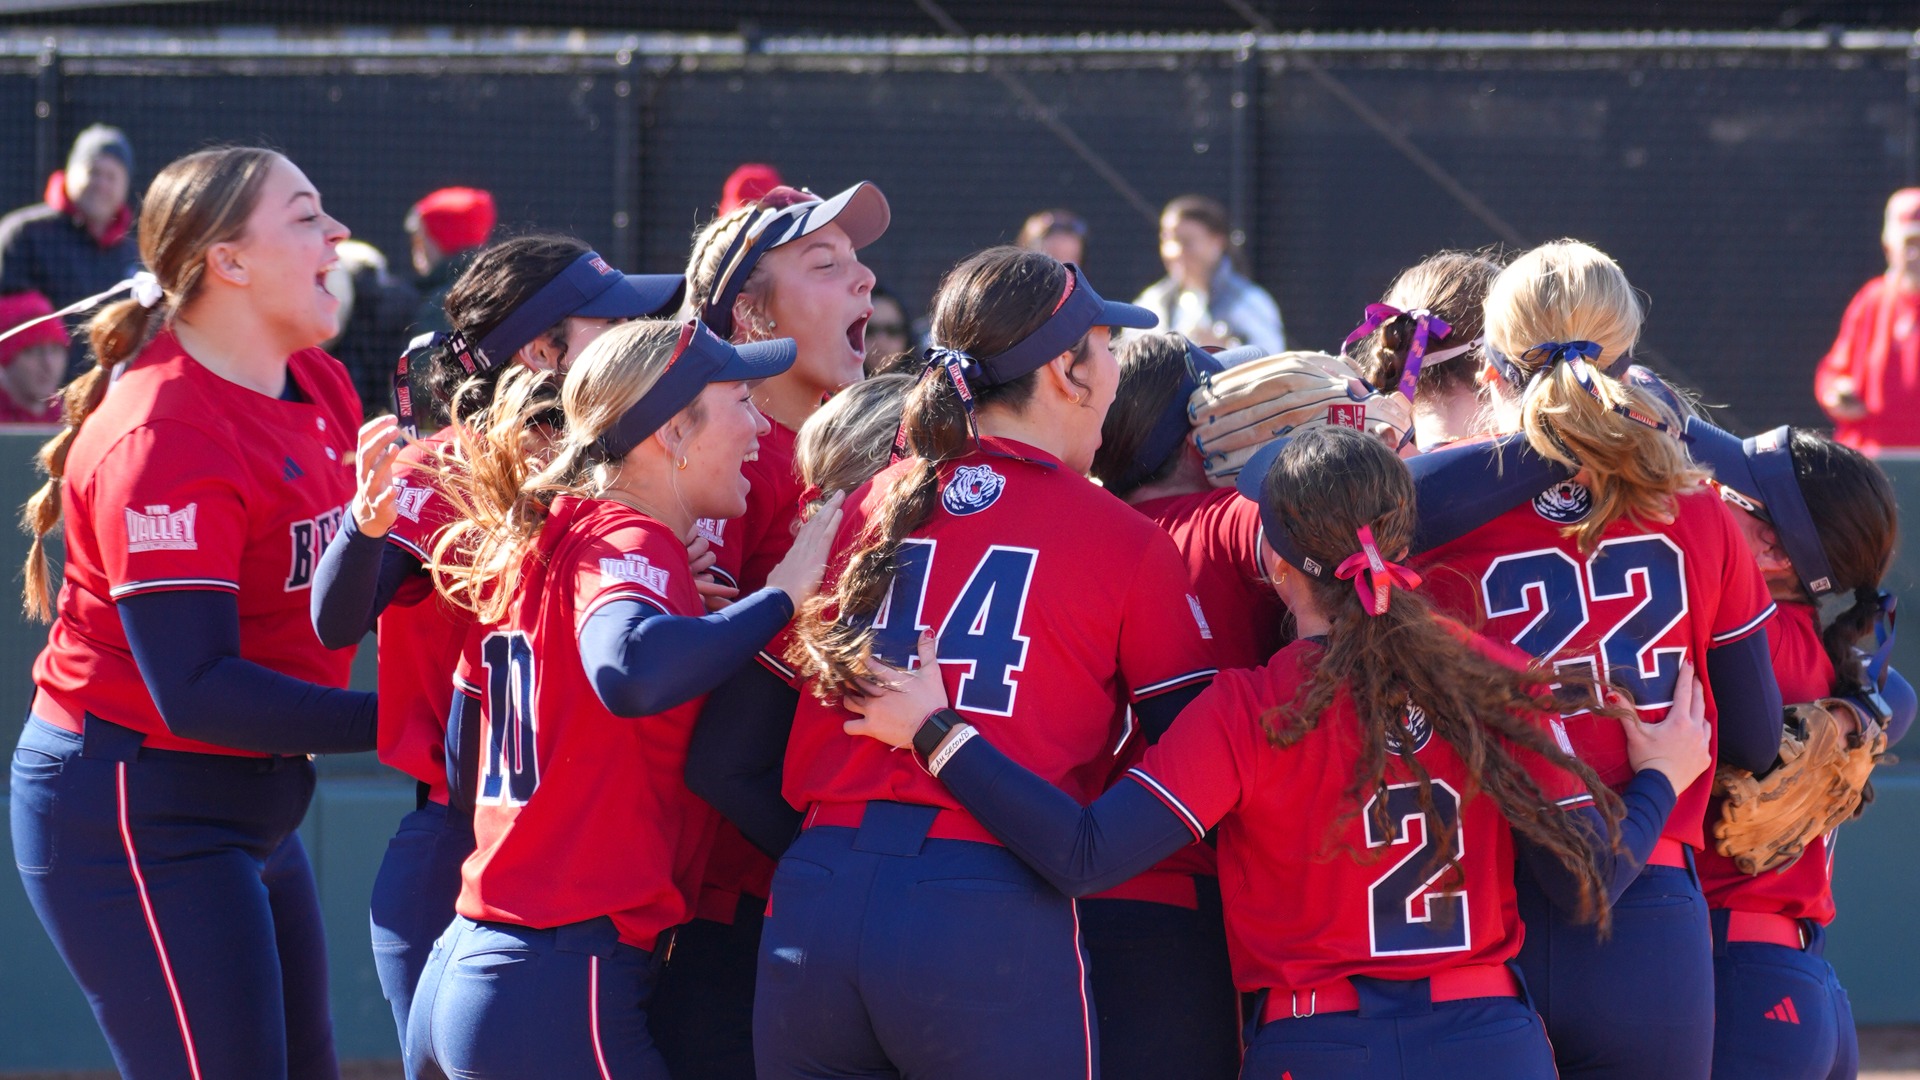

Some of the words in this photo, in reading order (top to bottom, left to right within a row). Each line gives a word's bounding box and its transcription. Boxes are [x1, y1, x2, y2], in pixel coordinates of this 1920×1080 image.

[397, 386, 412, 417] BRUINS
[948, 362, 973, 402] BELMONT
[124, 502, 198, 543] VALLEY
[599, 557, 670, 594] VALLEY
[848, 537, 1039, 717] 44
[1481, 533, 1688, 718] 22
[476, 629, 540, 807] 10
[936, 755, 946, 769] AM
[945, 730, 970, 758] SECOND
[1363, 778, 1471, 957] 2
